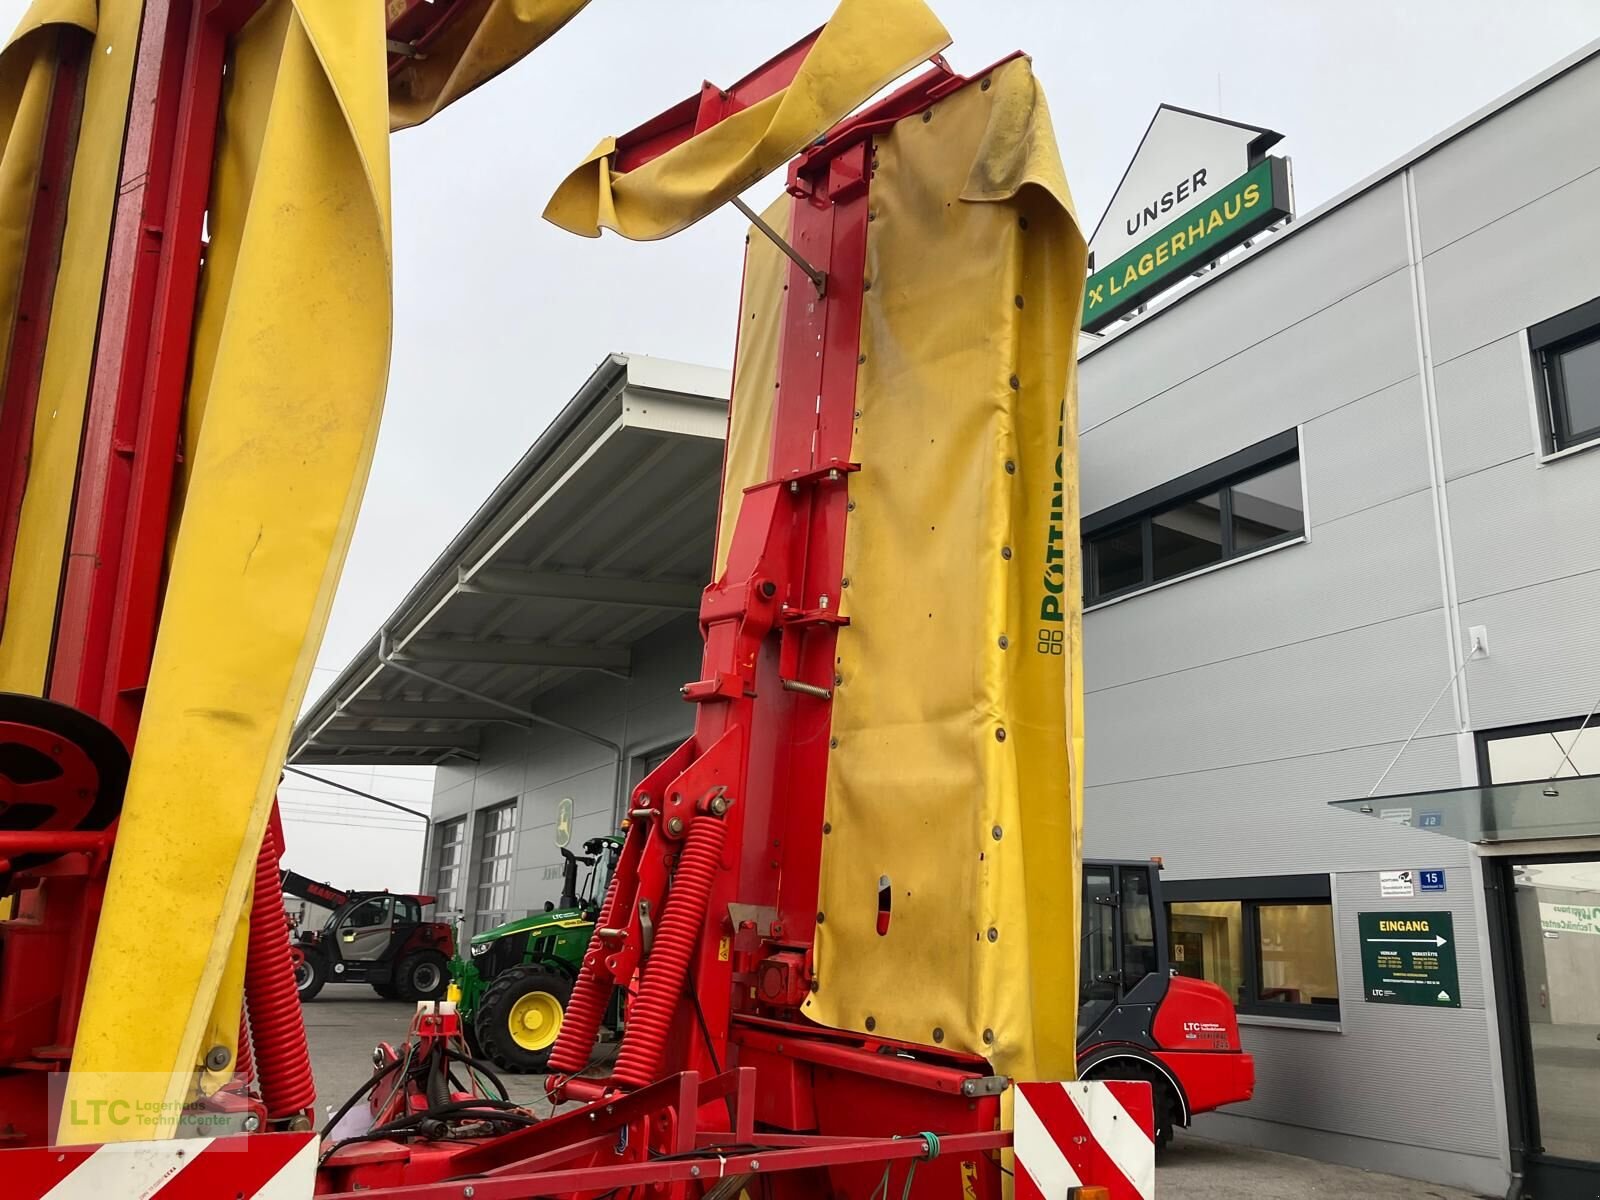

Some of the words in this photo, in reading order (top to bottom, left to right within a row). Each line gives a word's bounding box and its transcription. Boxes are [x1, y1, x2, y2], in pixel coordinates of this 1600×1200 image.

[1126, 168, 1207, 236] UNSER
[1109, 183, 1261, 296] LAGERHAUS
[1425, 873, 1438, 883] 15
[1379, 920, 1430, 932] EINGANG
[1183, 1022, 1200, 1031] LTC
